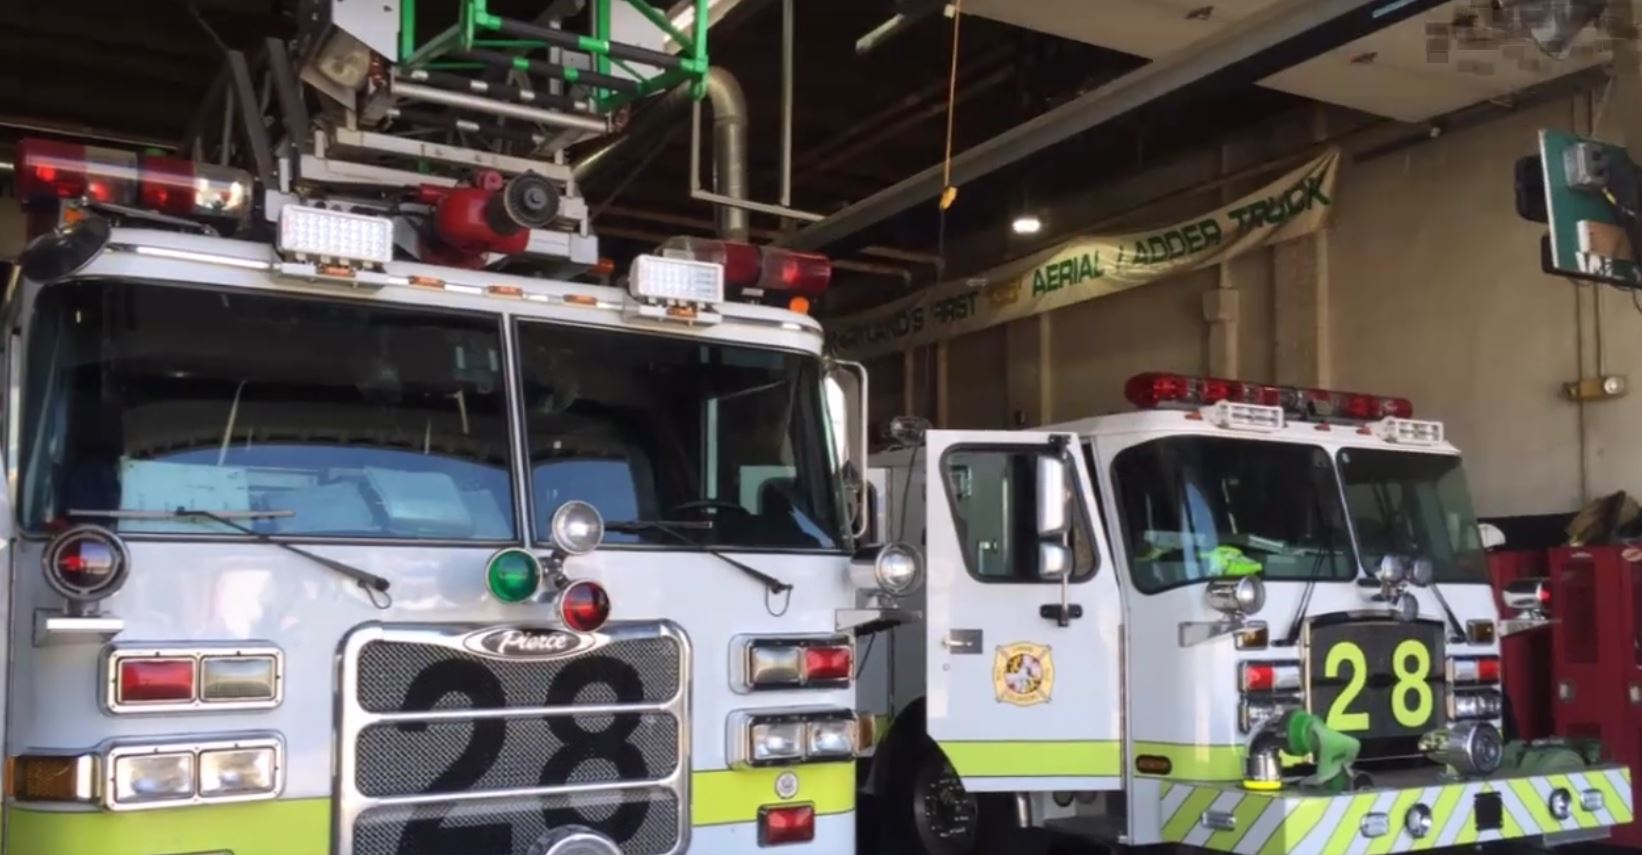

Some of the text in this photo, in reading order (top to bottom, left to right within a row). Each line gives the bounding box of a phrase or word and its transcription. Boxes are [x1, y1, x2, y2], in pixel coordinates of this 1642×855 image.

[1032, 250, 1104, 297] AERIAL
[1117, 218, 1222, 268] LADDER
[1227, 173, 1331, 235] TRUCK
[497, 629, 568, 655] Pierce
[1324, 639, 1433, 732] 28
[397, 655, 650, 855] 28
